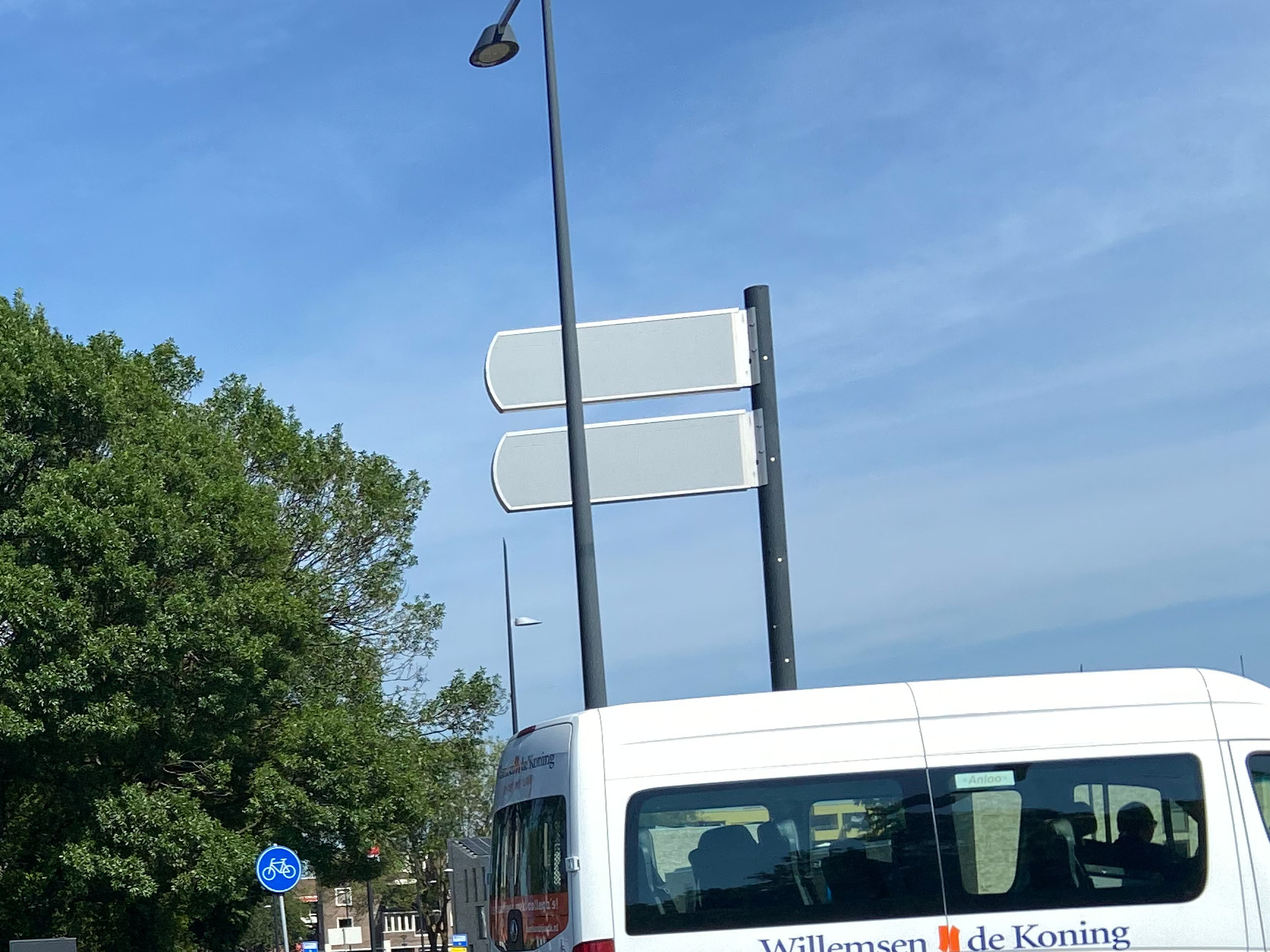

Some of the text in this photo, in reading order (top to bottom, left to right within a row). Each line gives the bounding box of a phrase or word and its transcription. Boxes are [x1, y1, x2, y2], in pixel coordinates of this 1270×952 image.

[528, 752, 555, 769] Koning
[967, 926, 1005, 951] de
[1012, 921, 1132, 951] Koning
